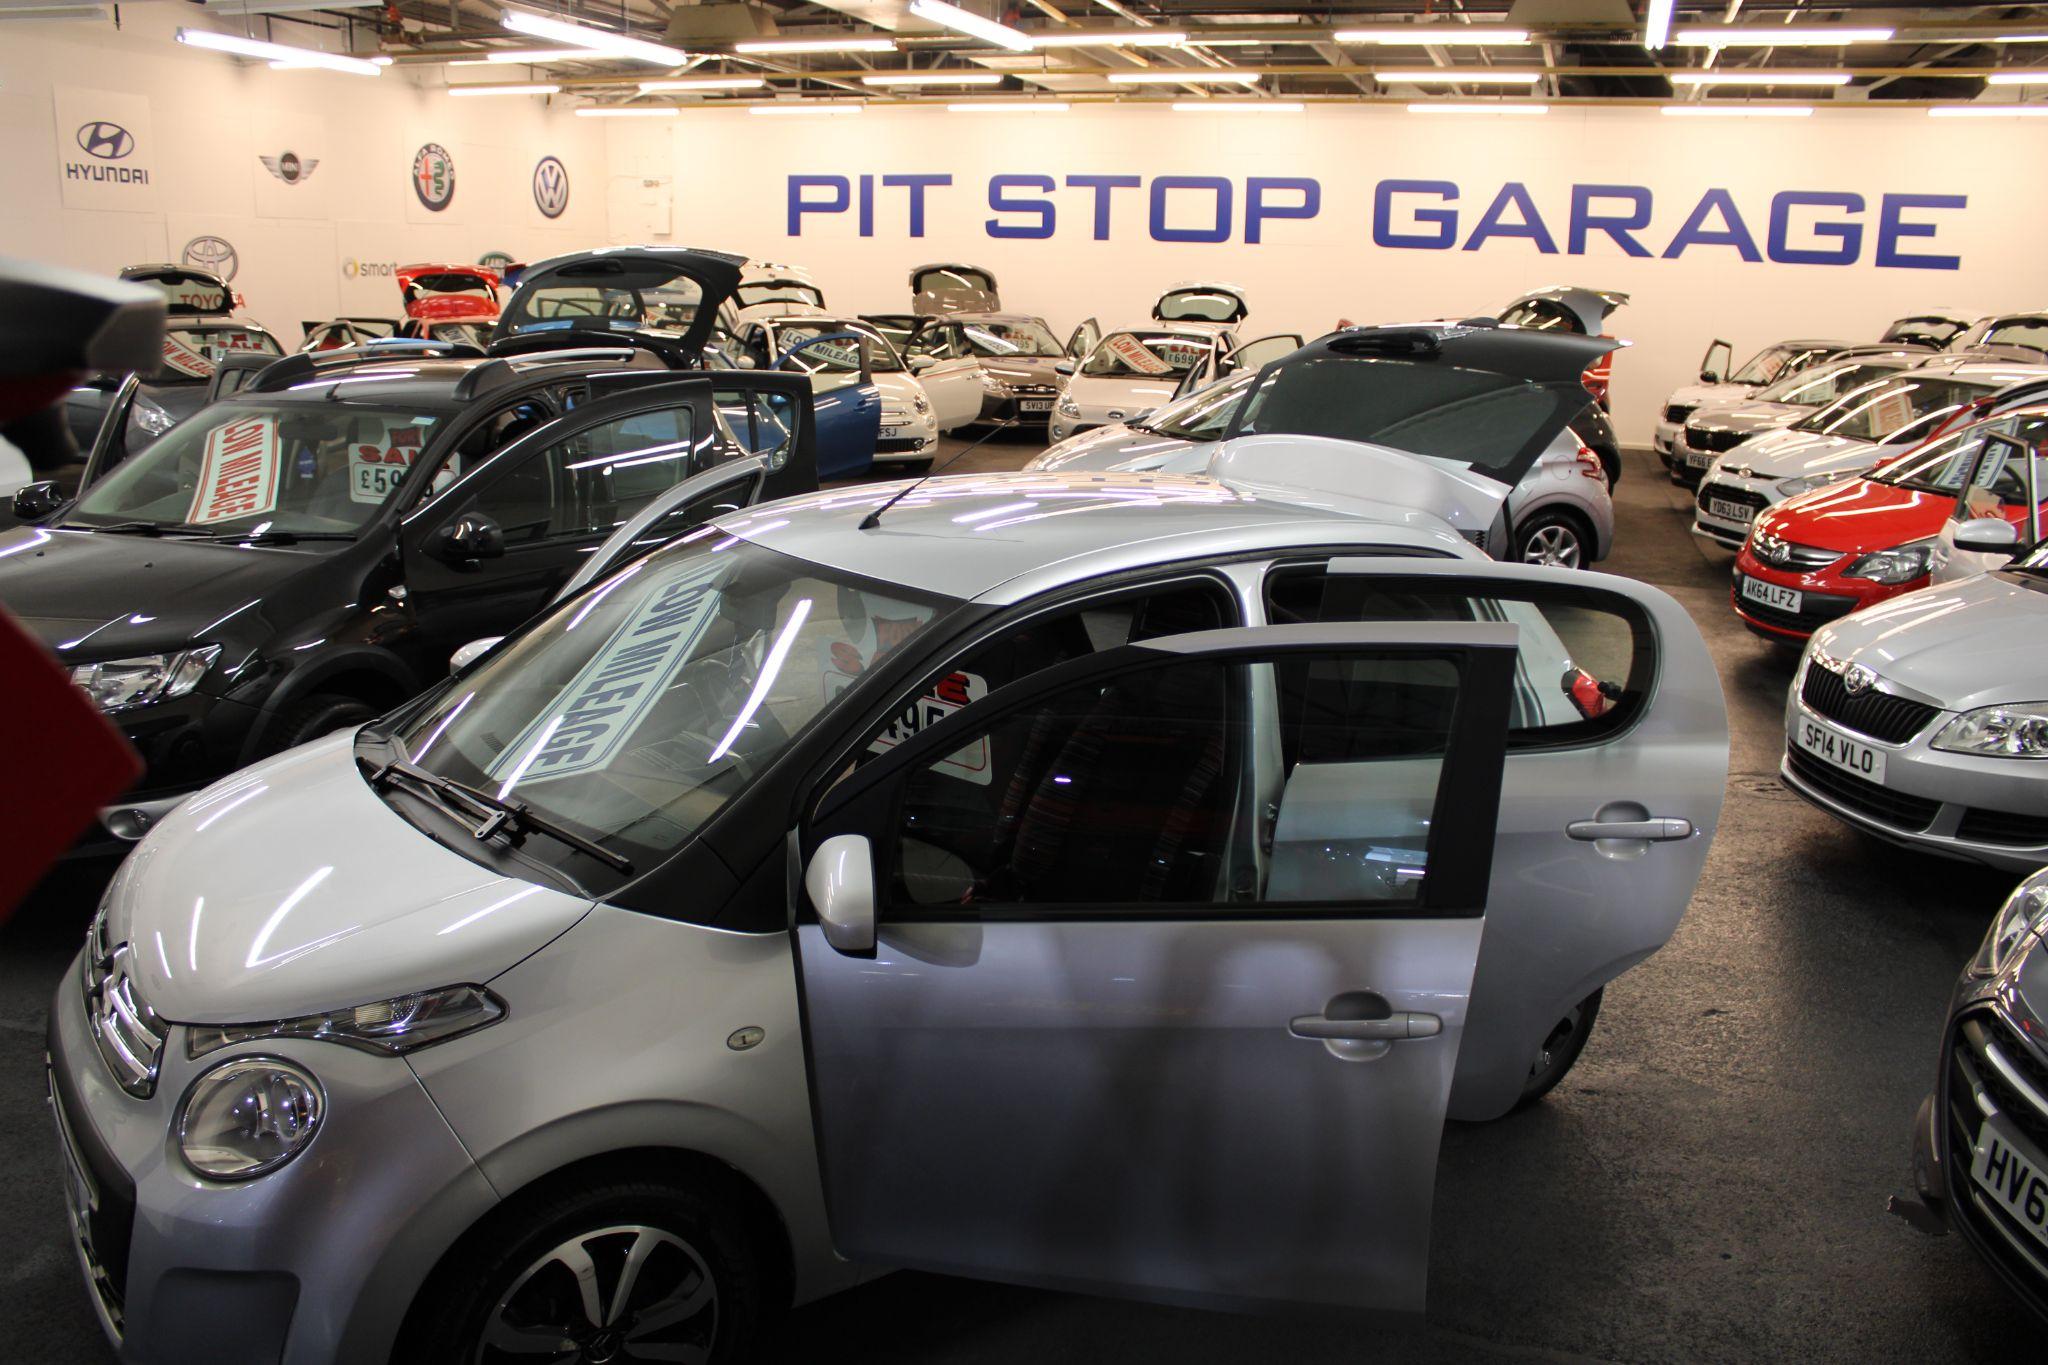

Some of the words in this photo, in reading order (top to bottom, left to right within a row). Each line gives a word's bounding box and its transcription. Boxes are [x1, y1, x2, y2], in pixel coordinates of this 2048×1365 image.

[66, 163, 149, 185] HYUNDAI
[787, 174, 953, 238] PIT
[985, 175, 1321, 244] STOP
[1372, 179, 1969, 270] GARAGE
[360, 262, 398, 277] smart
[180, 294, 246, 310] TOYOA
[813, 344, 860, 364] MILEAG
[222, 415, 265, 457] LOW
[208, 450, 263, 518] MILEAGE
[1713, 500, 1732, 516] YD63
[1733, 506, 1750, 519] LSV
[632, 563, 725, 637] LOW
[1746, 581, 1769, 602] AK64
[1770, 588, 1797, 608] LFZ
[526, 632, 682, 771] MILEAGE
[1805, 723, 1835, 759] SF14
[1840, 739, 1873, 774] VLO
[1984, 1138, 2048, 1226] HV6
